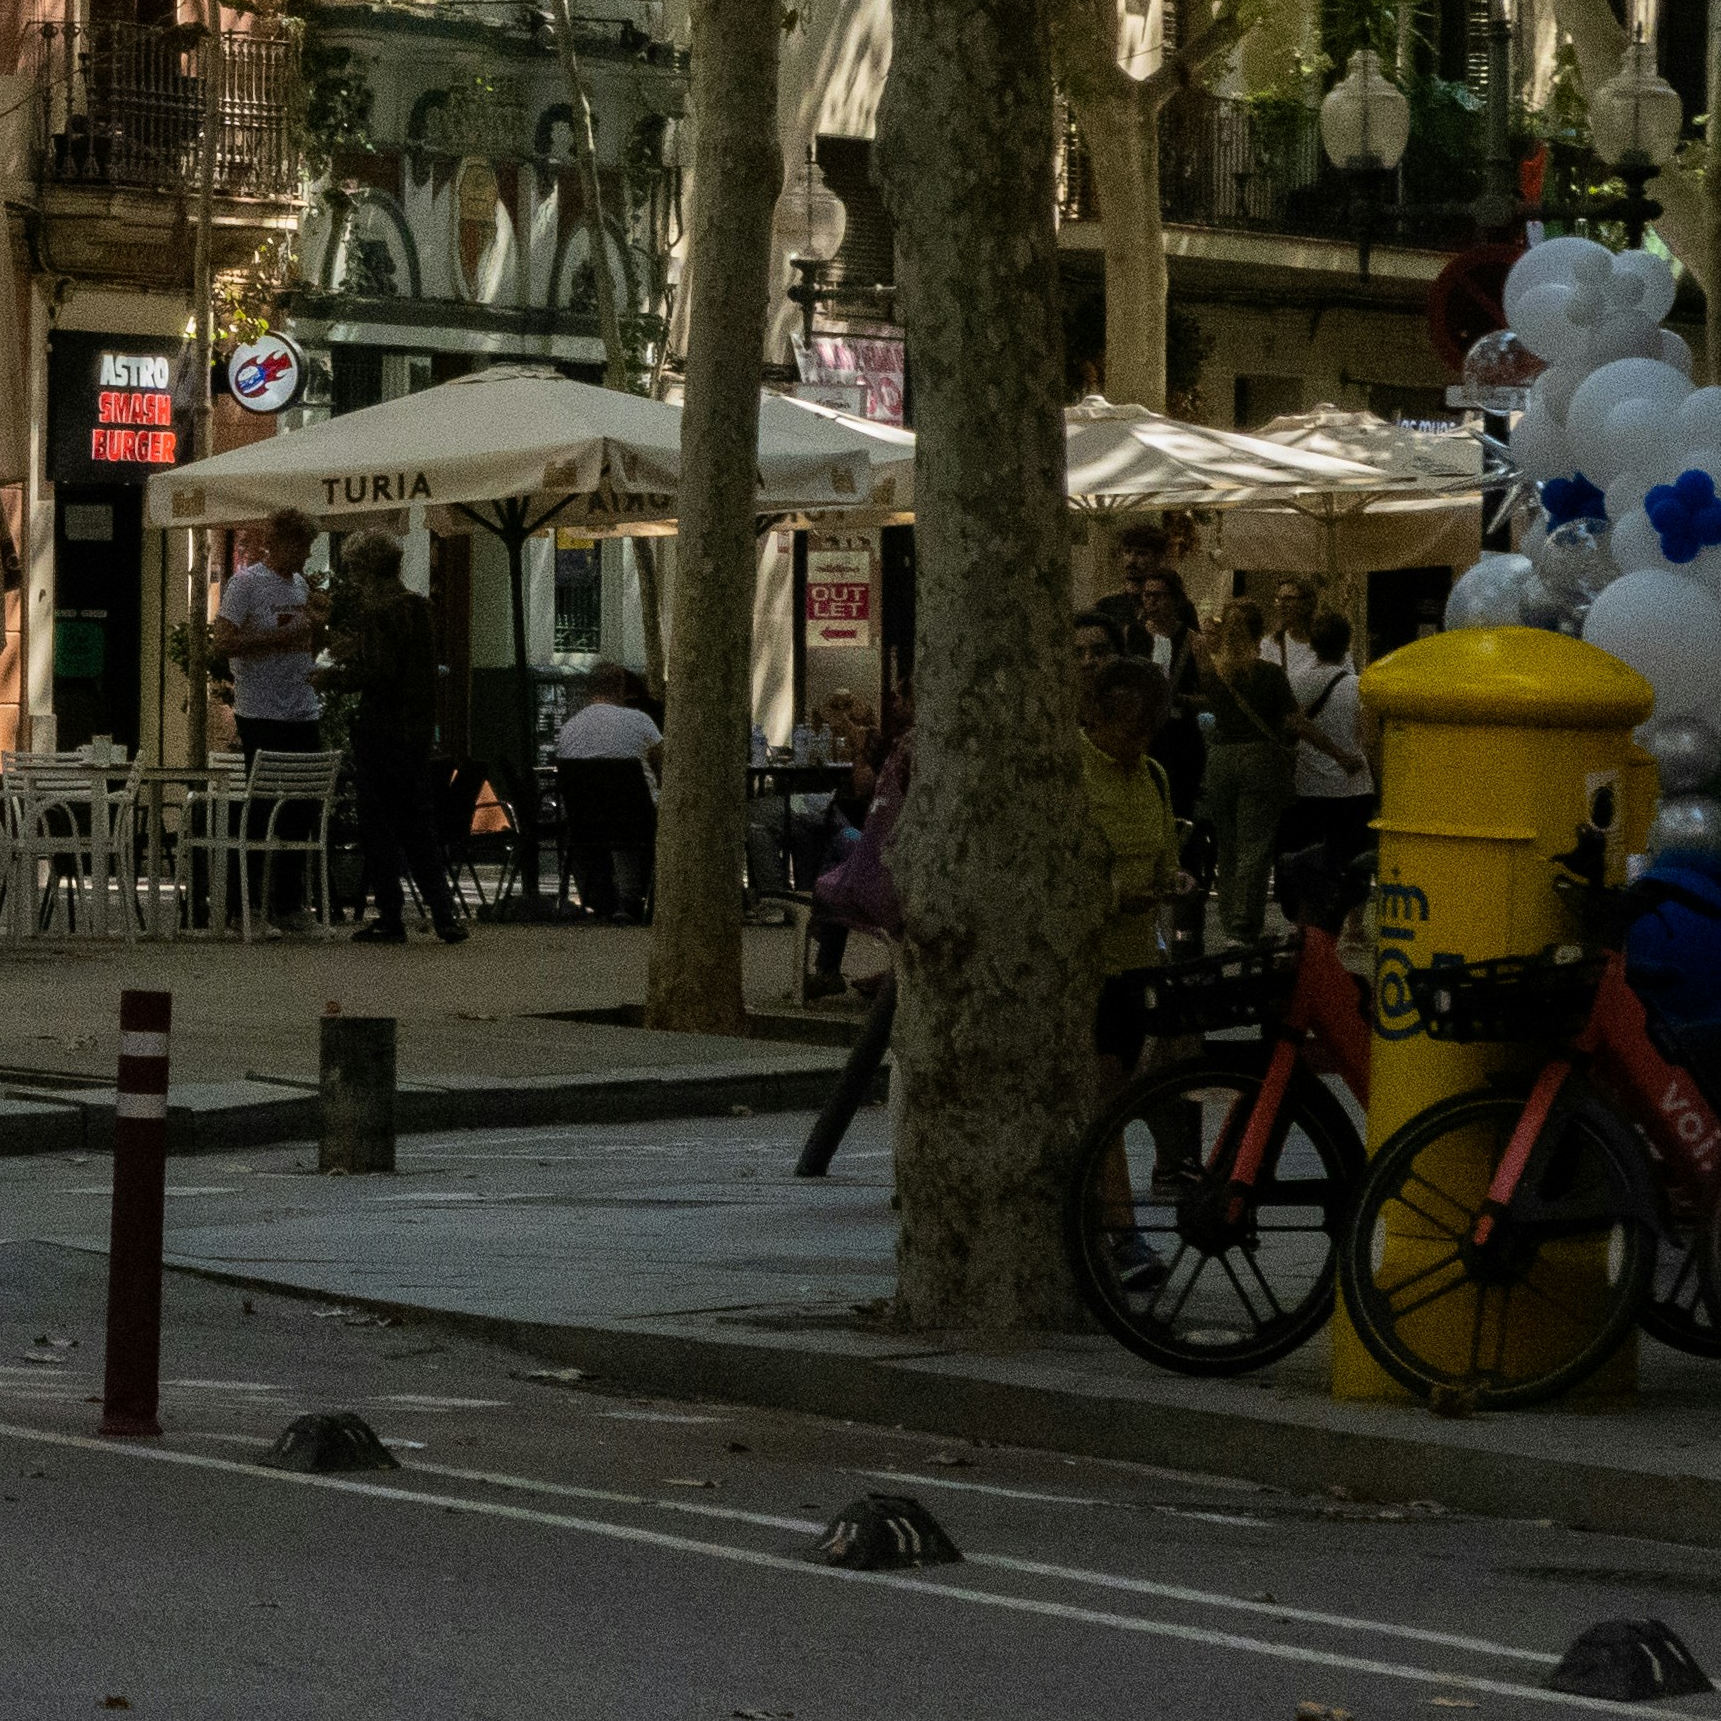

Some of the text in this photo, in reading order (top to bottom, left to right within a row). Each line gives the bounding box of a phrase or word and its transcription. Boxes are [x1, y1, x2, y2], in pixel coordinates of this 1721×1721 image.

[100, 354, 169, 389] ASTRO
[98, 391, 171, 426] SMASH
[91, 428, 176, 463] BURGER
[321, 472, 432, 505] TURIA
[811, 586, 866, 602] OUT
[813, 602, 864, 617] LET
